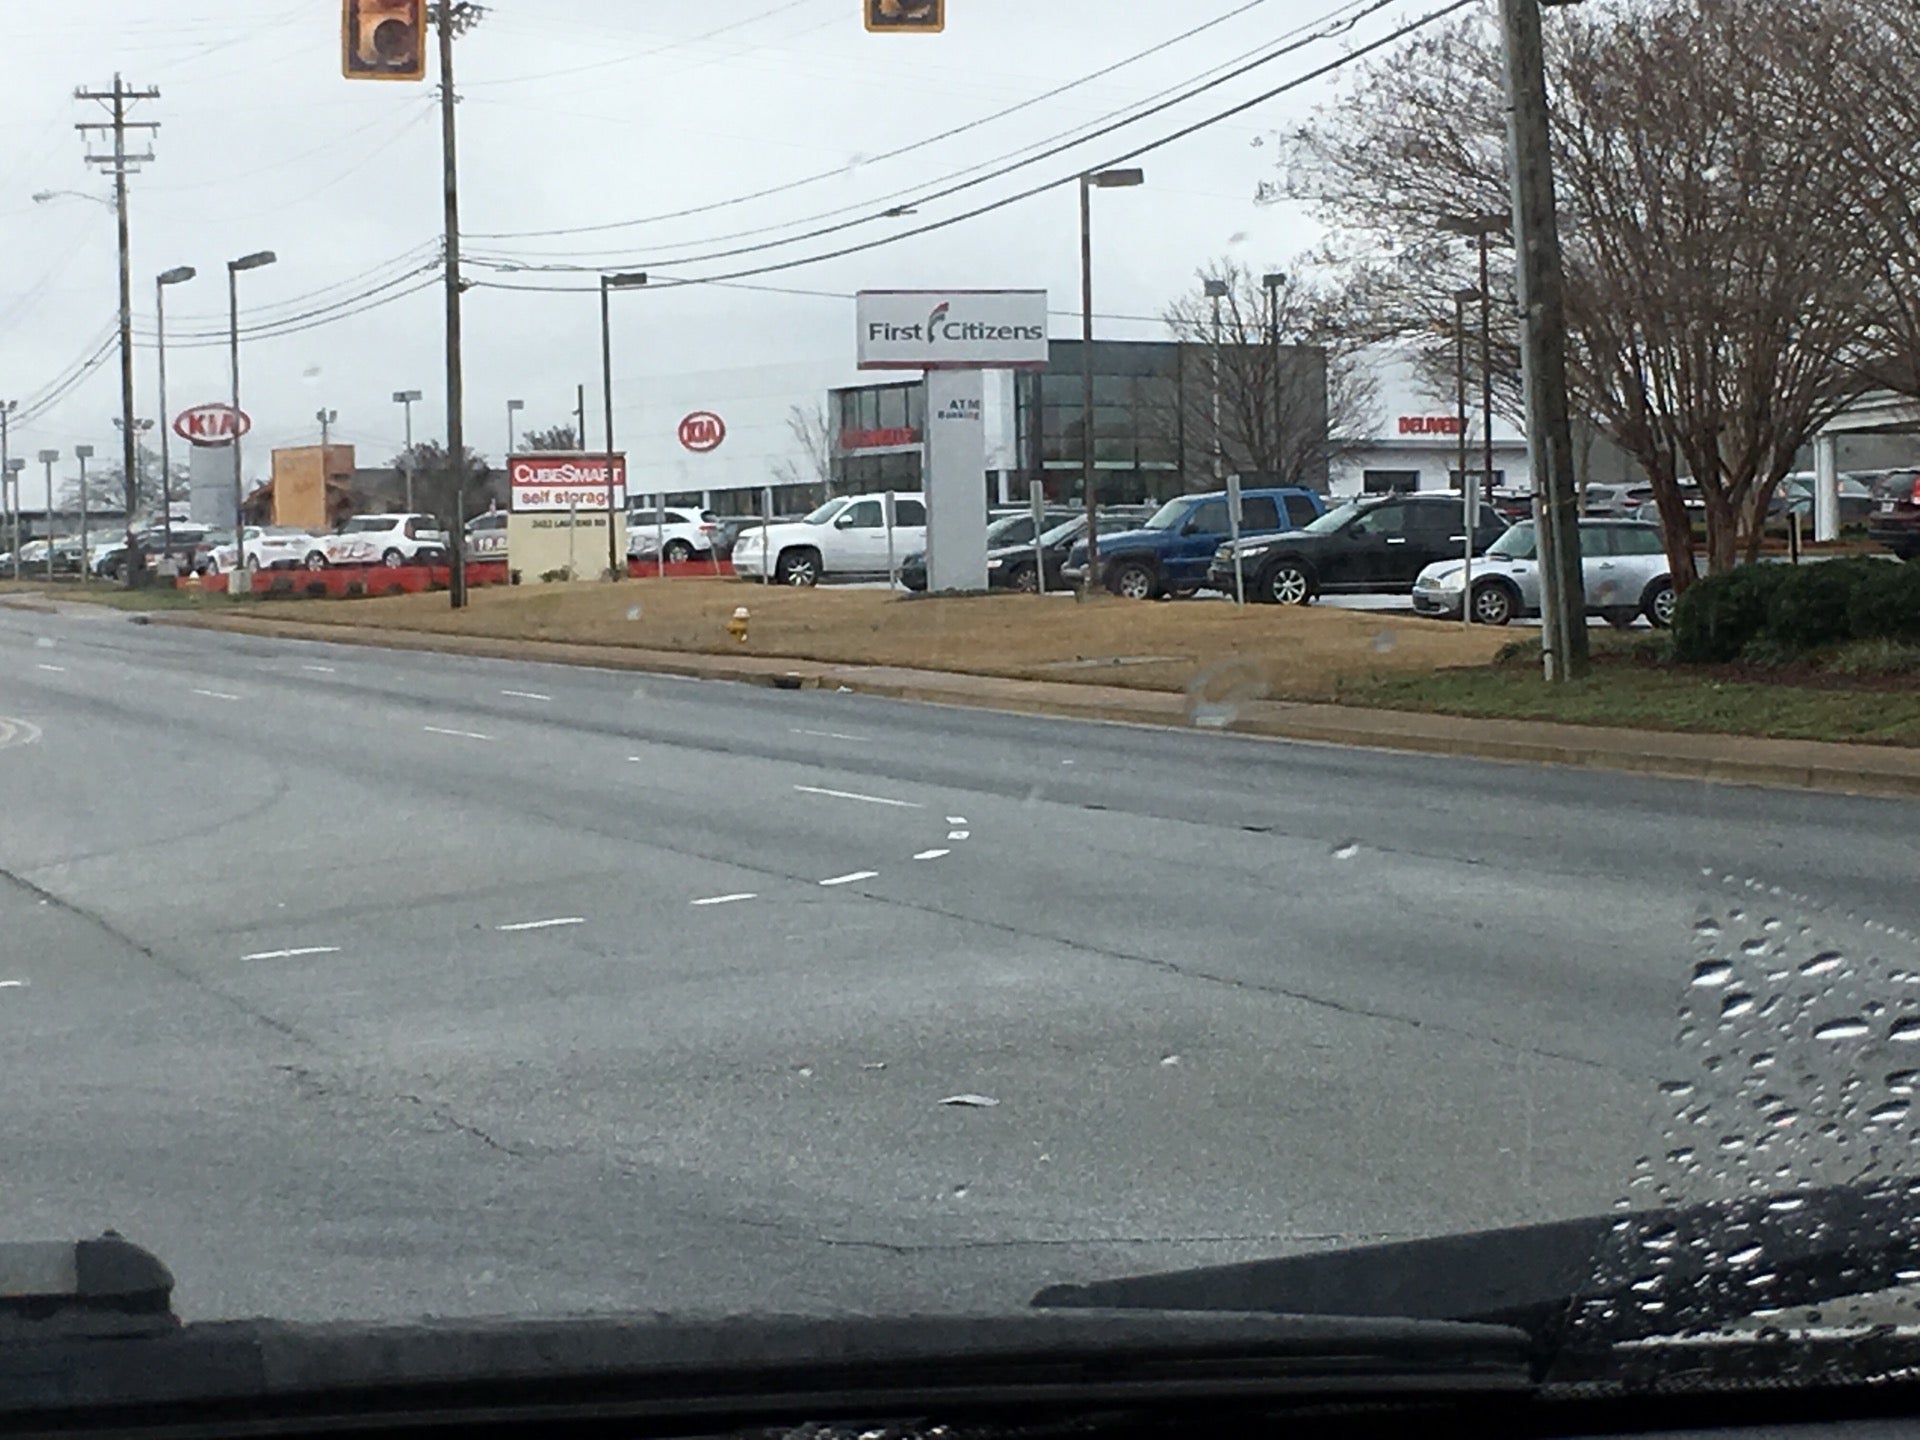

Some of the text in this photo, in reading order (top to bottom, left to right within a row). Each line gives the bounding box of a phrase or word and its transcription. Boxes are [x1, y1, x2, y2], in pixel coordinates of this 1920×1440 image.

[869, 321, 1043, 341] First Citizens
[949, 400, 979, 410] ATM
[188, 413, 239, 435] KIA
[938, 411, 979, 420] Banking
[687, 419, 719, 443] KIA
[522, 489, 612, 507] self storag
